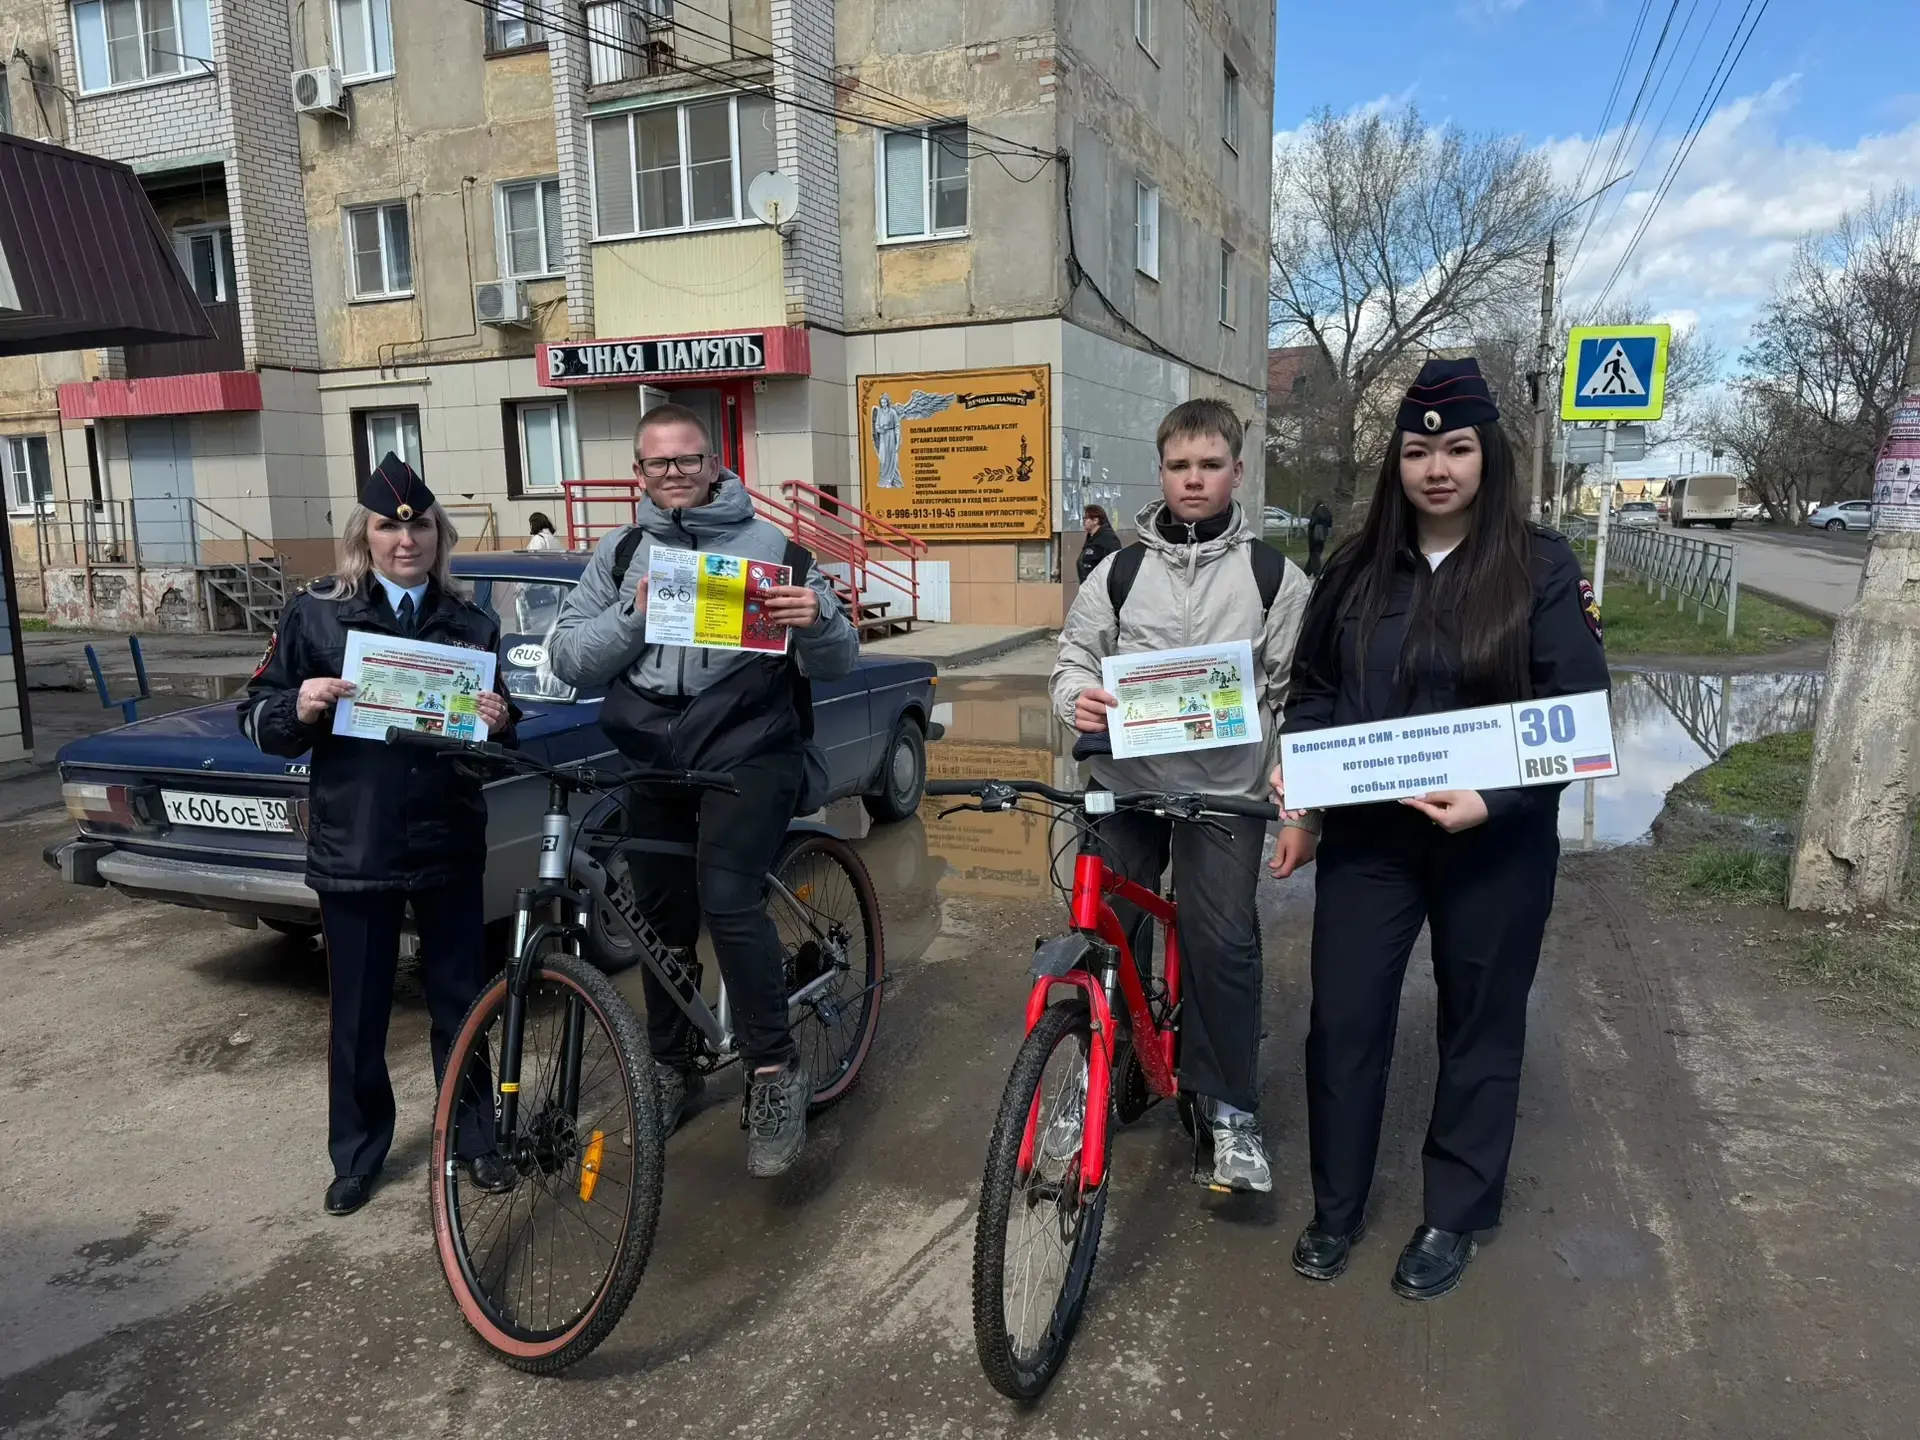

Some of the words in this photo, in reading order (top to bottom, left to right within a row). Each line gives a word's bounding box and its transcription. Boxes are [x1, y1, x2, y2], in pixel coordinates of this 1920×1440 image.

[656, 336, 763, 370] ПАМЯТЬ
[967, 396, 995, 407] ВЕЧНАЯ
[996, 395, 1027, 405] ПАМЯТЬ
[909, 426, 932, 434] ПОЛНЫЙ
[933, 425, 963, 433] КОМПЛЕКС
[963, 424, 1000, 432] РИТУАЛЬНЫХ
[910, 436, 948, 444] ОРГАНИЗАЦИЯ
[948, 435, 974, 443] ПОХОРОН
[956, 445, 989, 453] УСТАНОВКА:
[886, 508, 956, 519] 8-996-913-19-45
[957, 509, 984, 518] (ЗВОНКИ
[984, 508, 1038, 517] КРУГЛОСУТОЧНО)
[513, 648, 543, 661] RUS
[1519, 704, 1576, 747] 30
[1292, 735, 1357, 754] Велосипед
[1358, 736, 1366, 746] и
[1368, 730, 1394, 744] СИМ
[1401, 726, 1450, 740] верные
[1452, 718, 1502, 735] друзья,
[1342, 756, 1395, 771] которые
[1398, 749, 1449, 767] требуют
[1525, 755, 1568, 778] RUS
[1350, 779, 1396, 794] особых
[1398, 773, 1449, 790] правил!
[173, 797, 261, 828] К606ОЕ
[262, 801, 287, 821] 30
[266, 820, 285, 829] RUS
[541, 837, 556, 850] R
[608, 887, 688, 987] ROCKET
